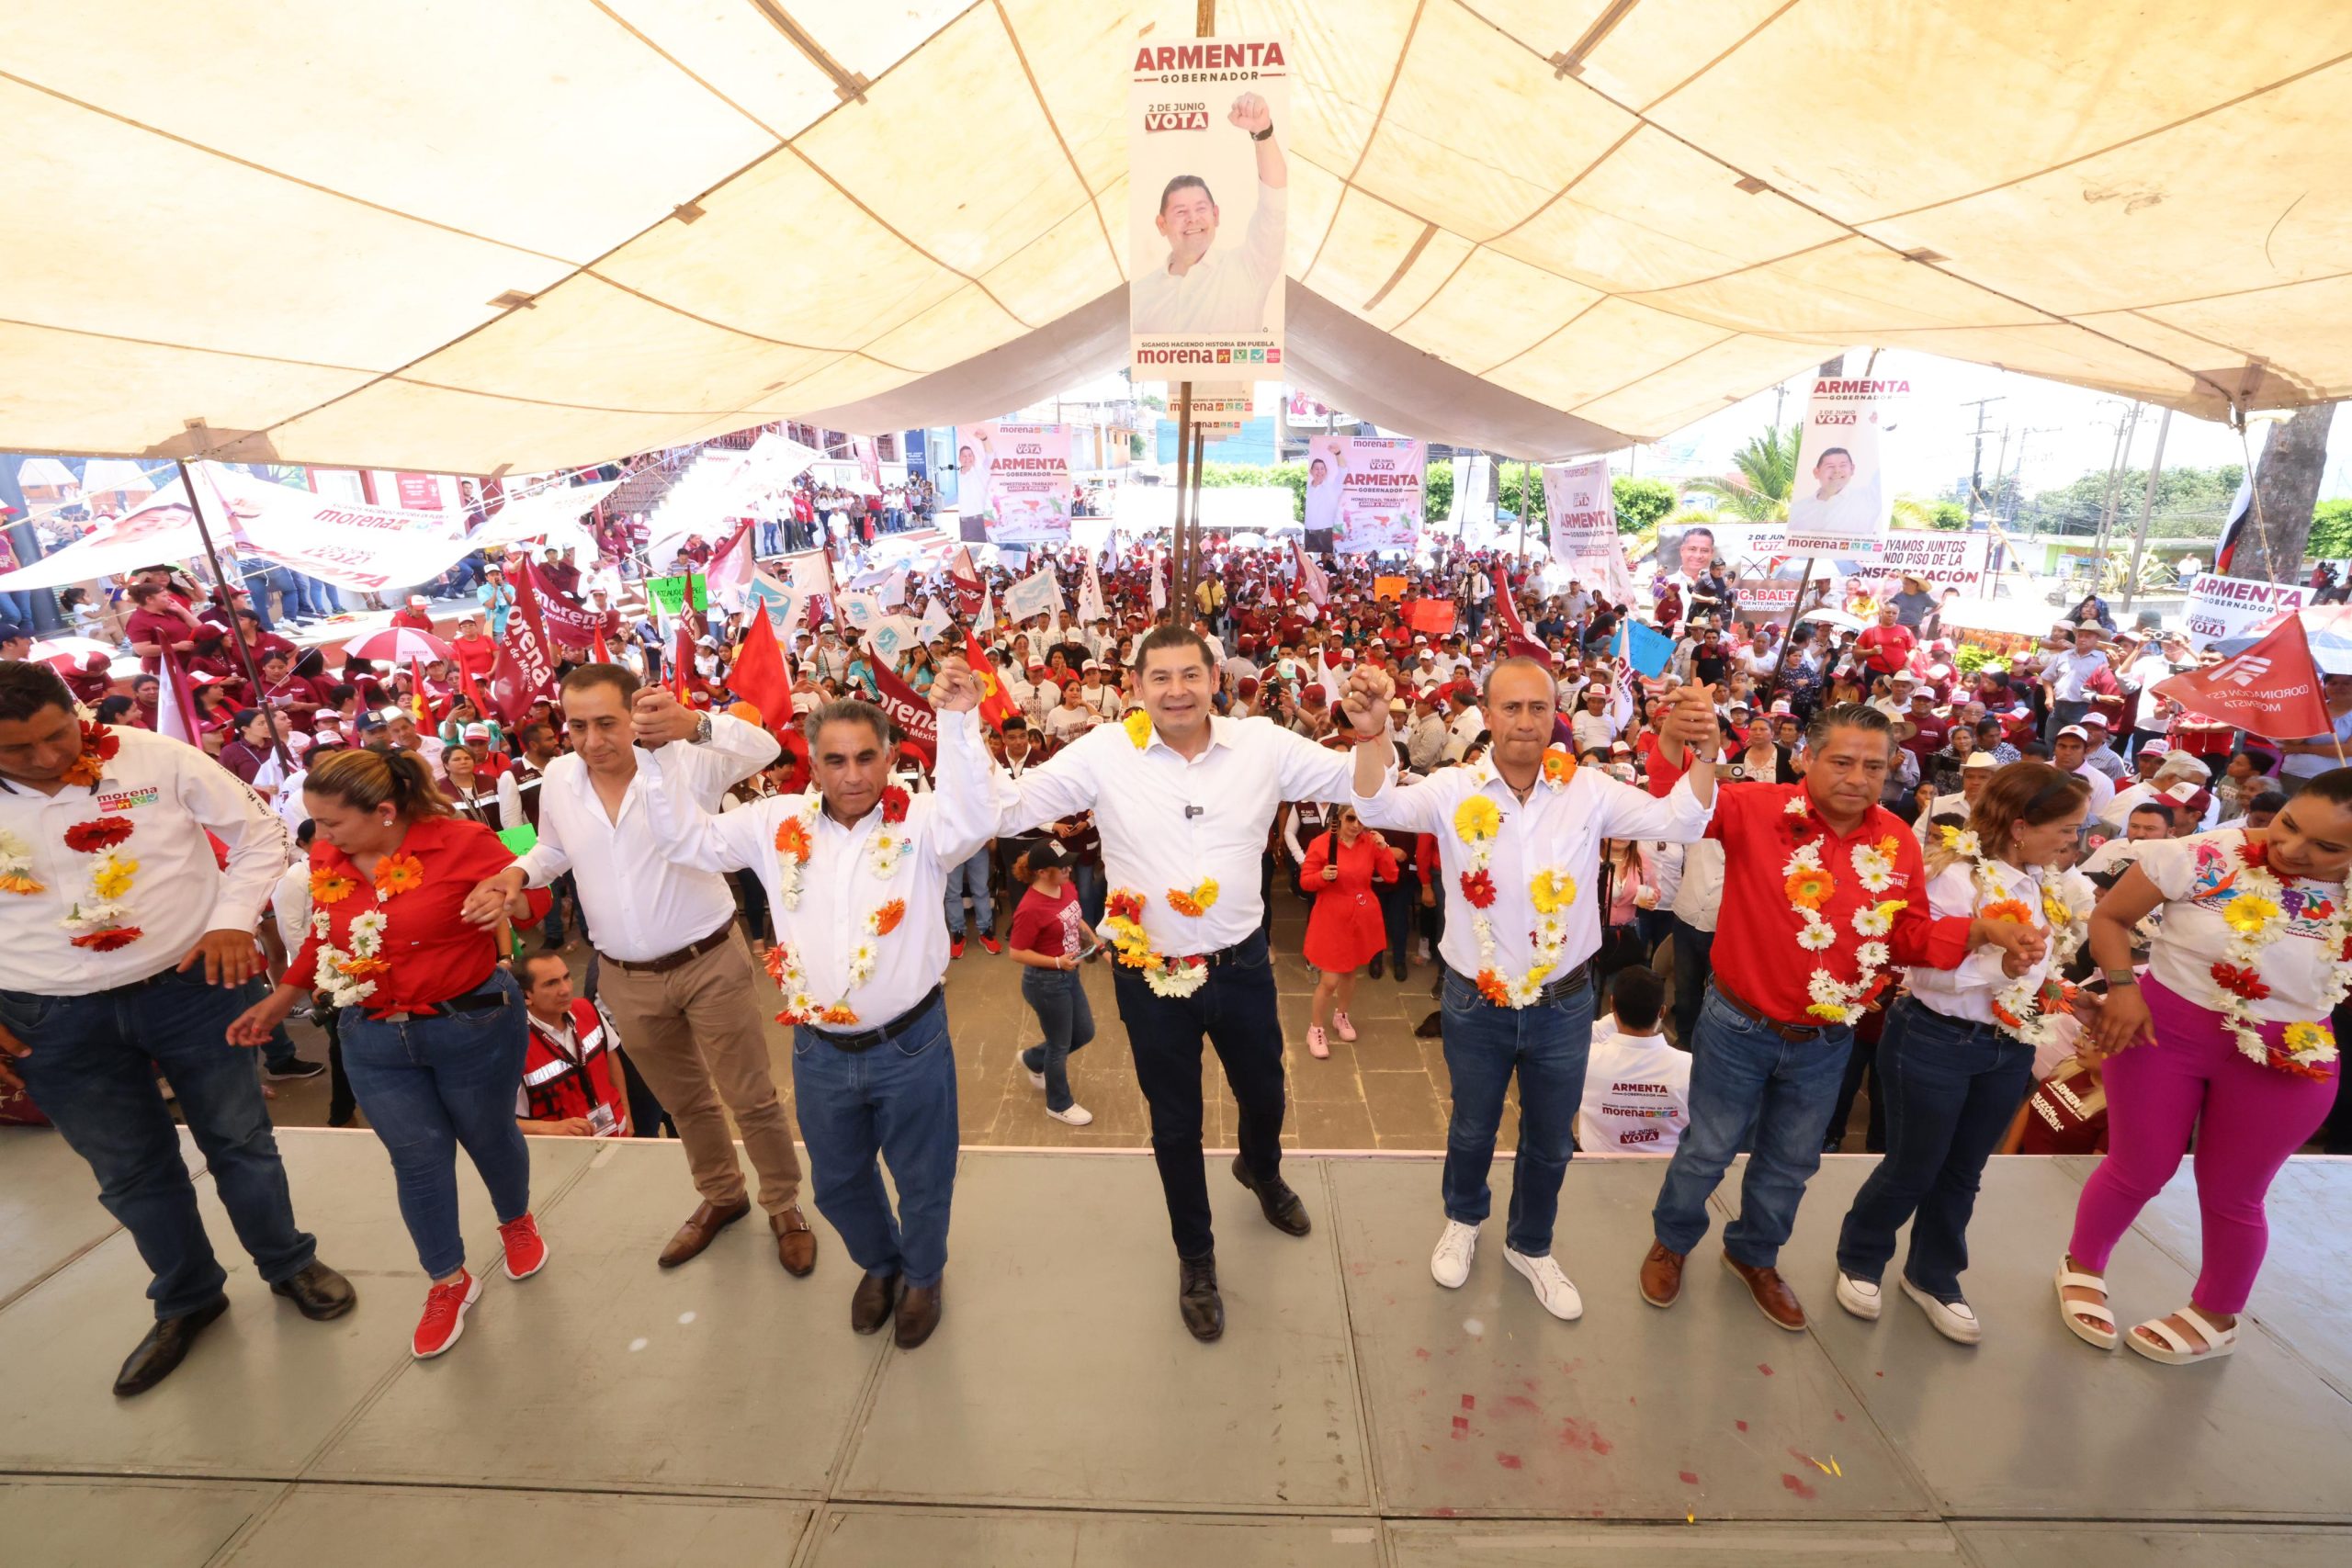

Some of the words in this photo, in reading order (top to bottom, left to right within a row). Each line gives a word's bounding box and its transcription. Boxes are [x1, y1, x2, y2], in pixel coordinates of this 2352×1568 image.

[1134, 42, 1285, 72] ARMENTA
[1160, 72, 1259, 84] GOBERNADOR
[1148, 104, 1155, 112] 2
[1157, 103, 1171, 112] DE
[1172, 102, 1205, 112] JUNIO
[1147, 113, 1206, 130] VOTA
[1137, 349, 1213, 364] morena
[1218, 355, 1229, 363] PT
[1814, 380, 1910, 393] ARMENTA
[1816, 415, 1856, 424] VOTA
[990, 458, 1068, 470] ARMENTA
[1343, 473, 1419, 486] ARMENTA
[314, 510, 395, 530] morena
[1788, 539, 1838, 550] morena
[1926, 540, 1966, 553] JUNTOS
[1905, 553, 1929, 565] PISO
[1932, 553, 1948, 566] DE
[1949, 554, 1962, 567] LA
[2194, 578, 2301, 608] ARMENTA
[2203, 597, 2274, 614] GOBERNADOR
[2205, 615, 2225, 626] JUNIO
[96, 786, 158, 802] morena
[117, 802, 130, 810] PT
[1612, 1083, 1668, 1093] ARMENTA
[1602, 1107, 1645, 1117] morena
[1623, 1132, 1656, 1144] VOTA
